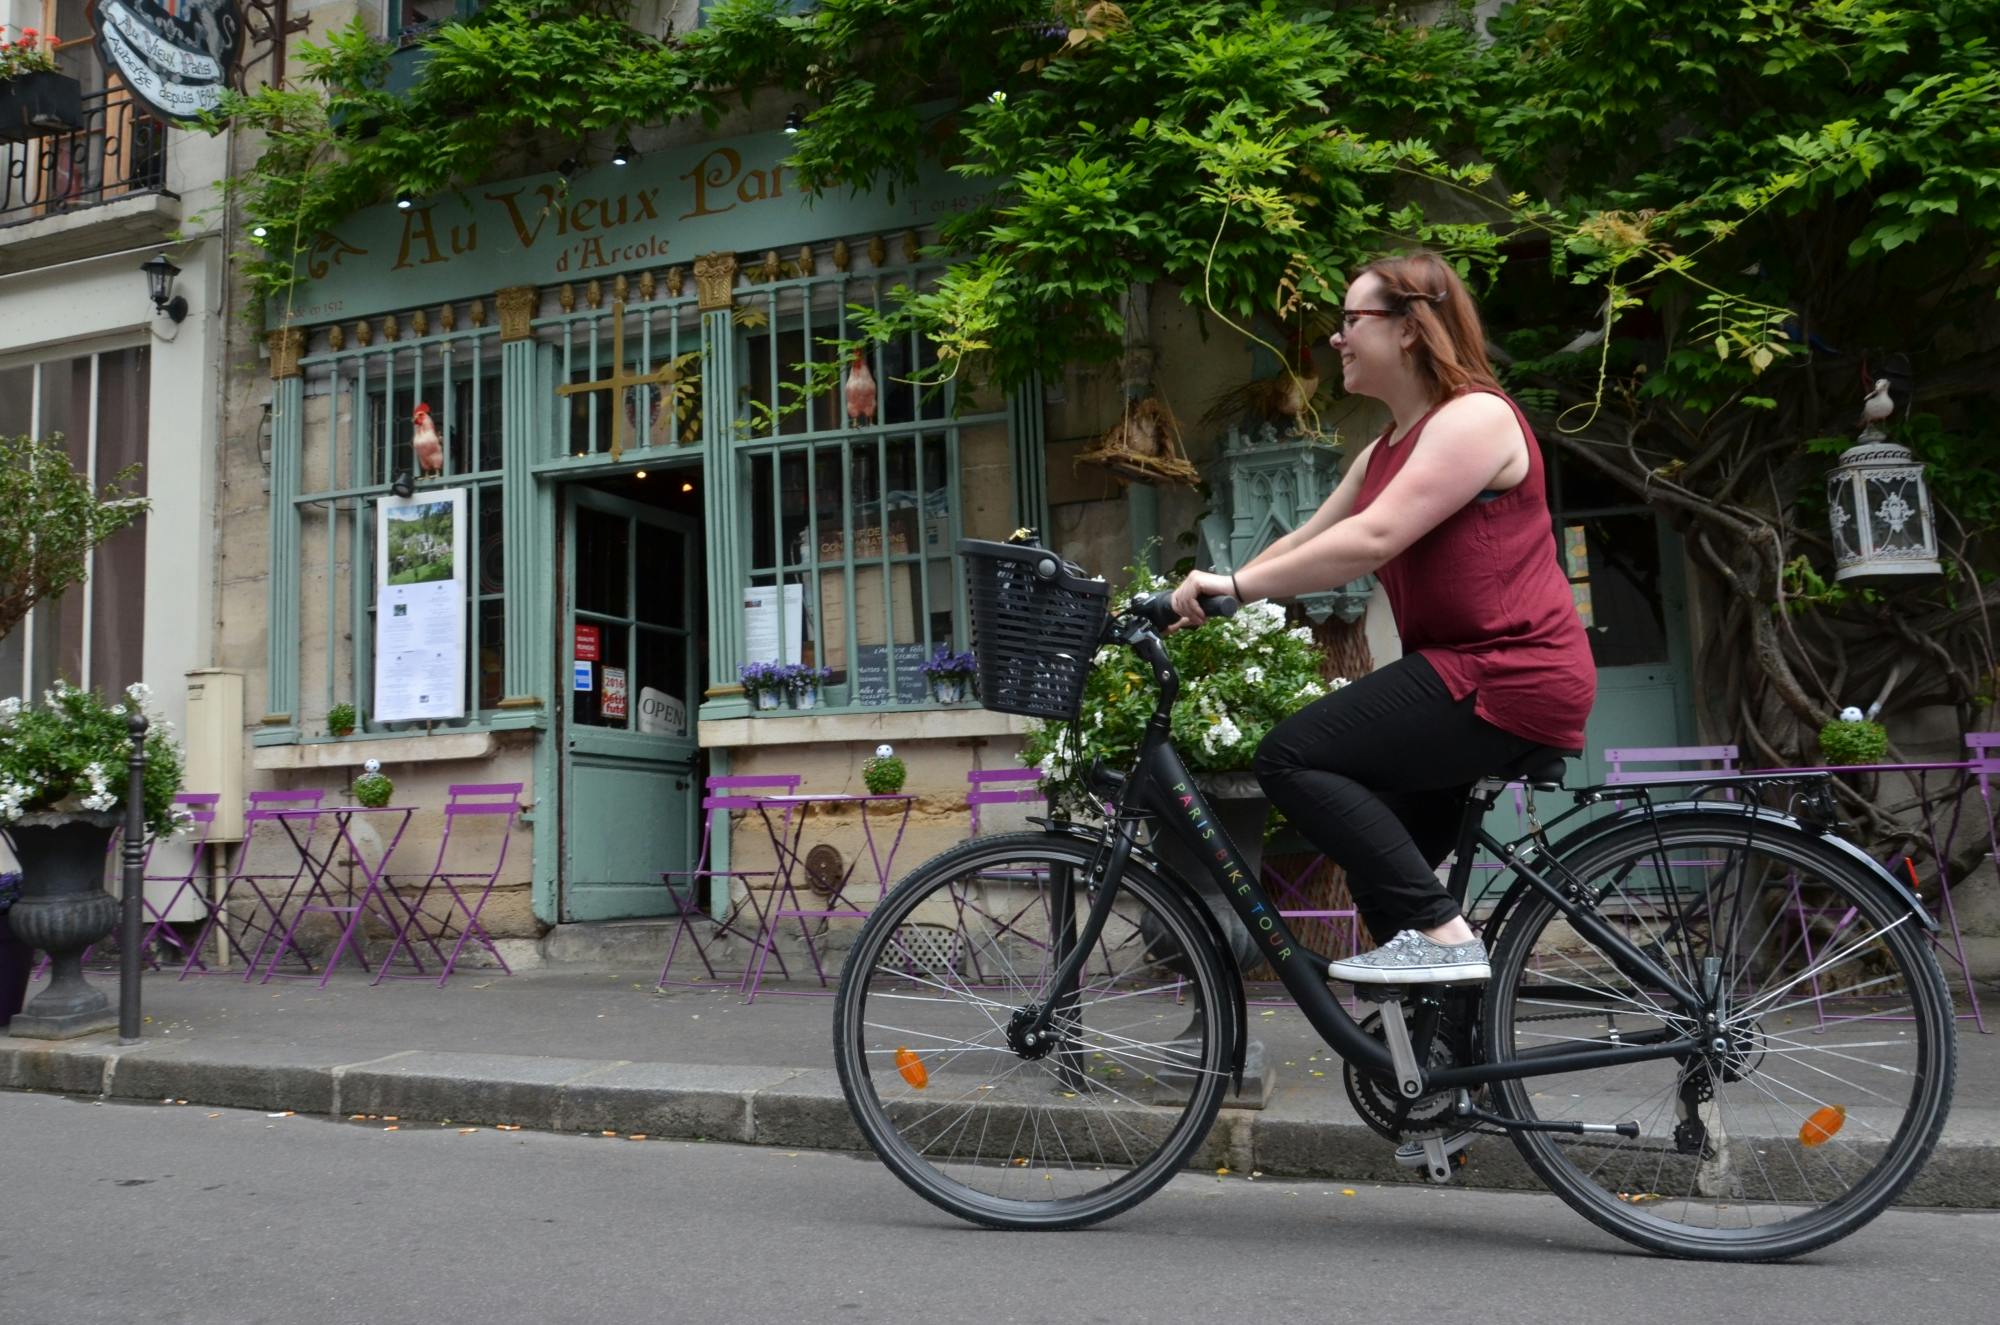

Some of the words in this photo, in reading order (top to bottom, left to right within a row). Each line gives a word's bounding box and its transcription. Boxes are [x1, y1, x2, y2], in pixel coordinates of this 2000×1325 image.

[109, 36, 152, 88] Auberge
[160, 89, 194, 109] depuis
[143, 31, 176, 69] Vieux
[181, 53, 212, 75] Paris
[391, 203, 476, 272] Au
[484, 183, 659, 249] Vieux
[679, 147, 846, 222] Par
[556, 235, 670, 273] d'Arcole
[643, 698, 684, 726] OPEN
[1172, 782, 1215, 840] PARIS
[1215, 848, 1250, 896] BIKE
[1251, 901, 1292, 961] TOUR
